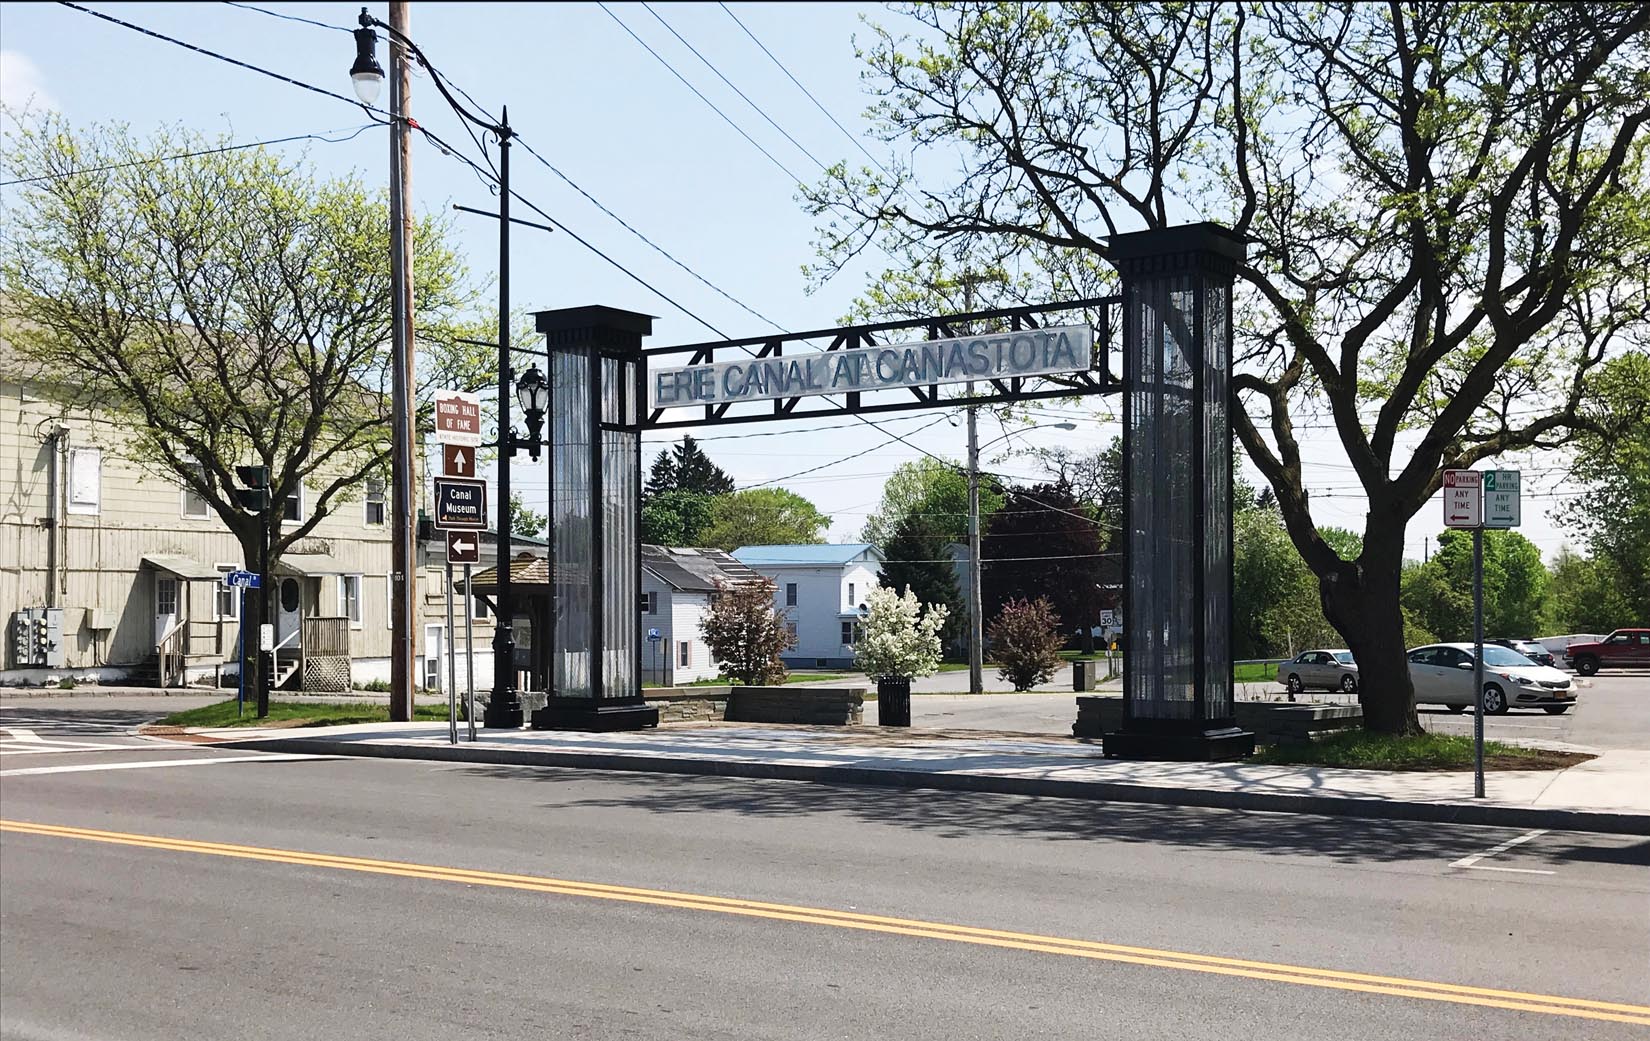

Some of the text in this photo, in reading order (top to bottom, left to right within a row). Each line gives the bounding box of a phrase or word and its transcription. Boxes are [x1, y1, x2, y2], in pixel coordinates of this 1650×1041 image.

[657, 332, 1079, 402] ERIE CANAL AT CANASTOTA
[439, 403, 476, 416] BOXING HALL
[446, 418, 471, 430] OF FAME
[1445, 474, 1478, 485] NO PARKING
[1486, 474, 1495, 488] 2
[1496, 482, 1518, 490] PARKING
[450, 489, 472, 500] Canal
[1455, 490, 1469, 498] ANY
[1496, 494, 1509, 502] ANY
[446, 503, 477, 514] Museum
[1495, 504, 1510, 512] TIME
[233, 574, 252, 587] Canal
